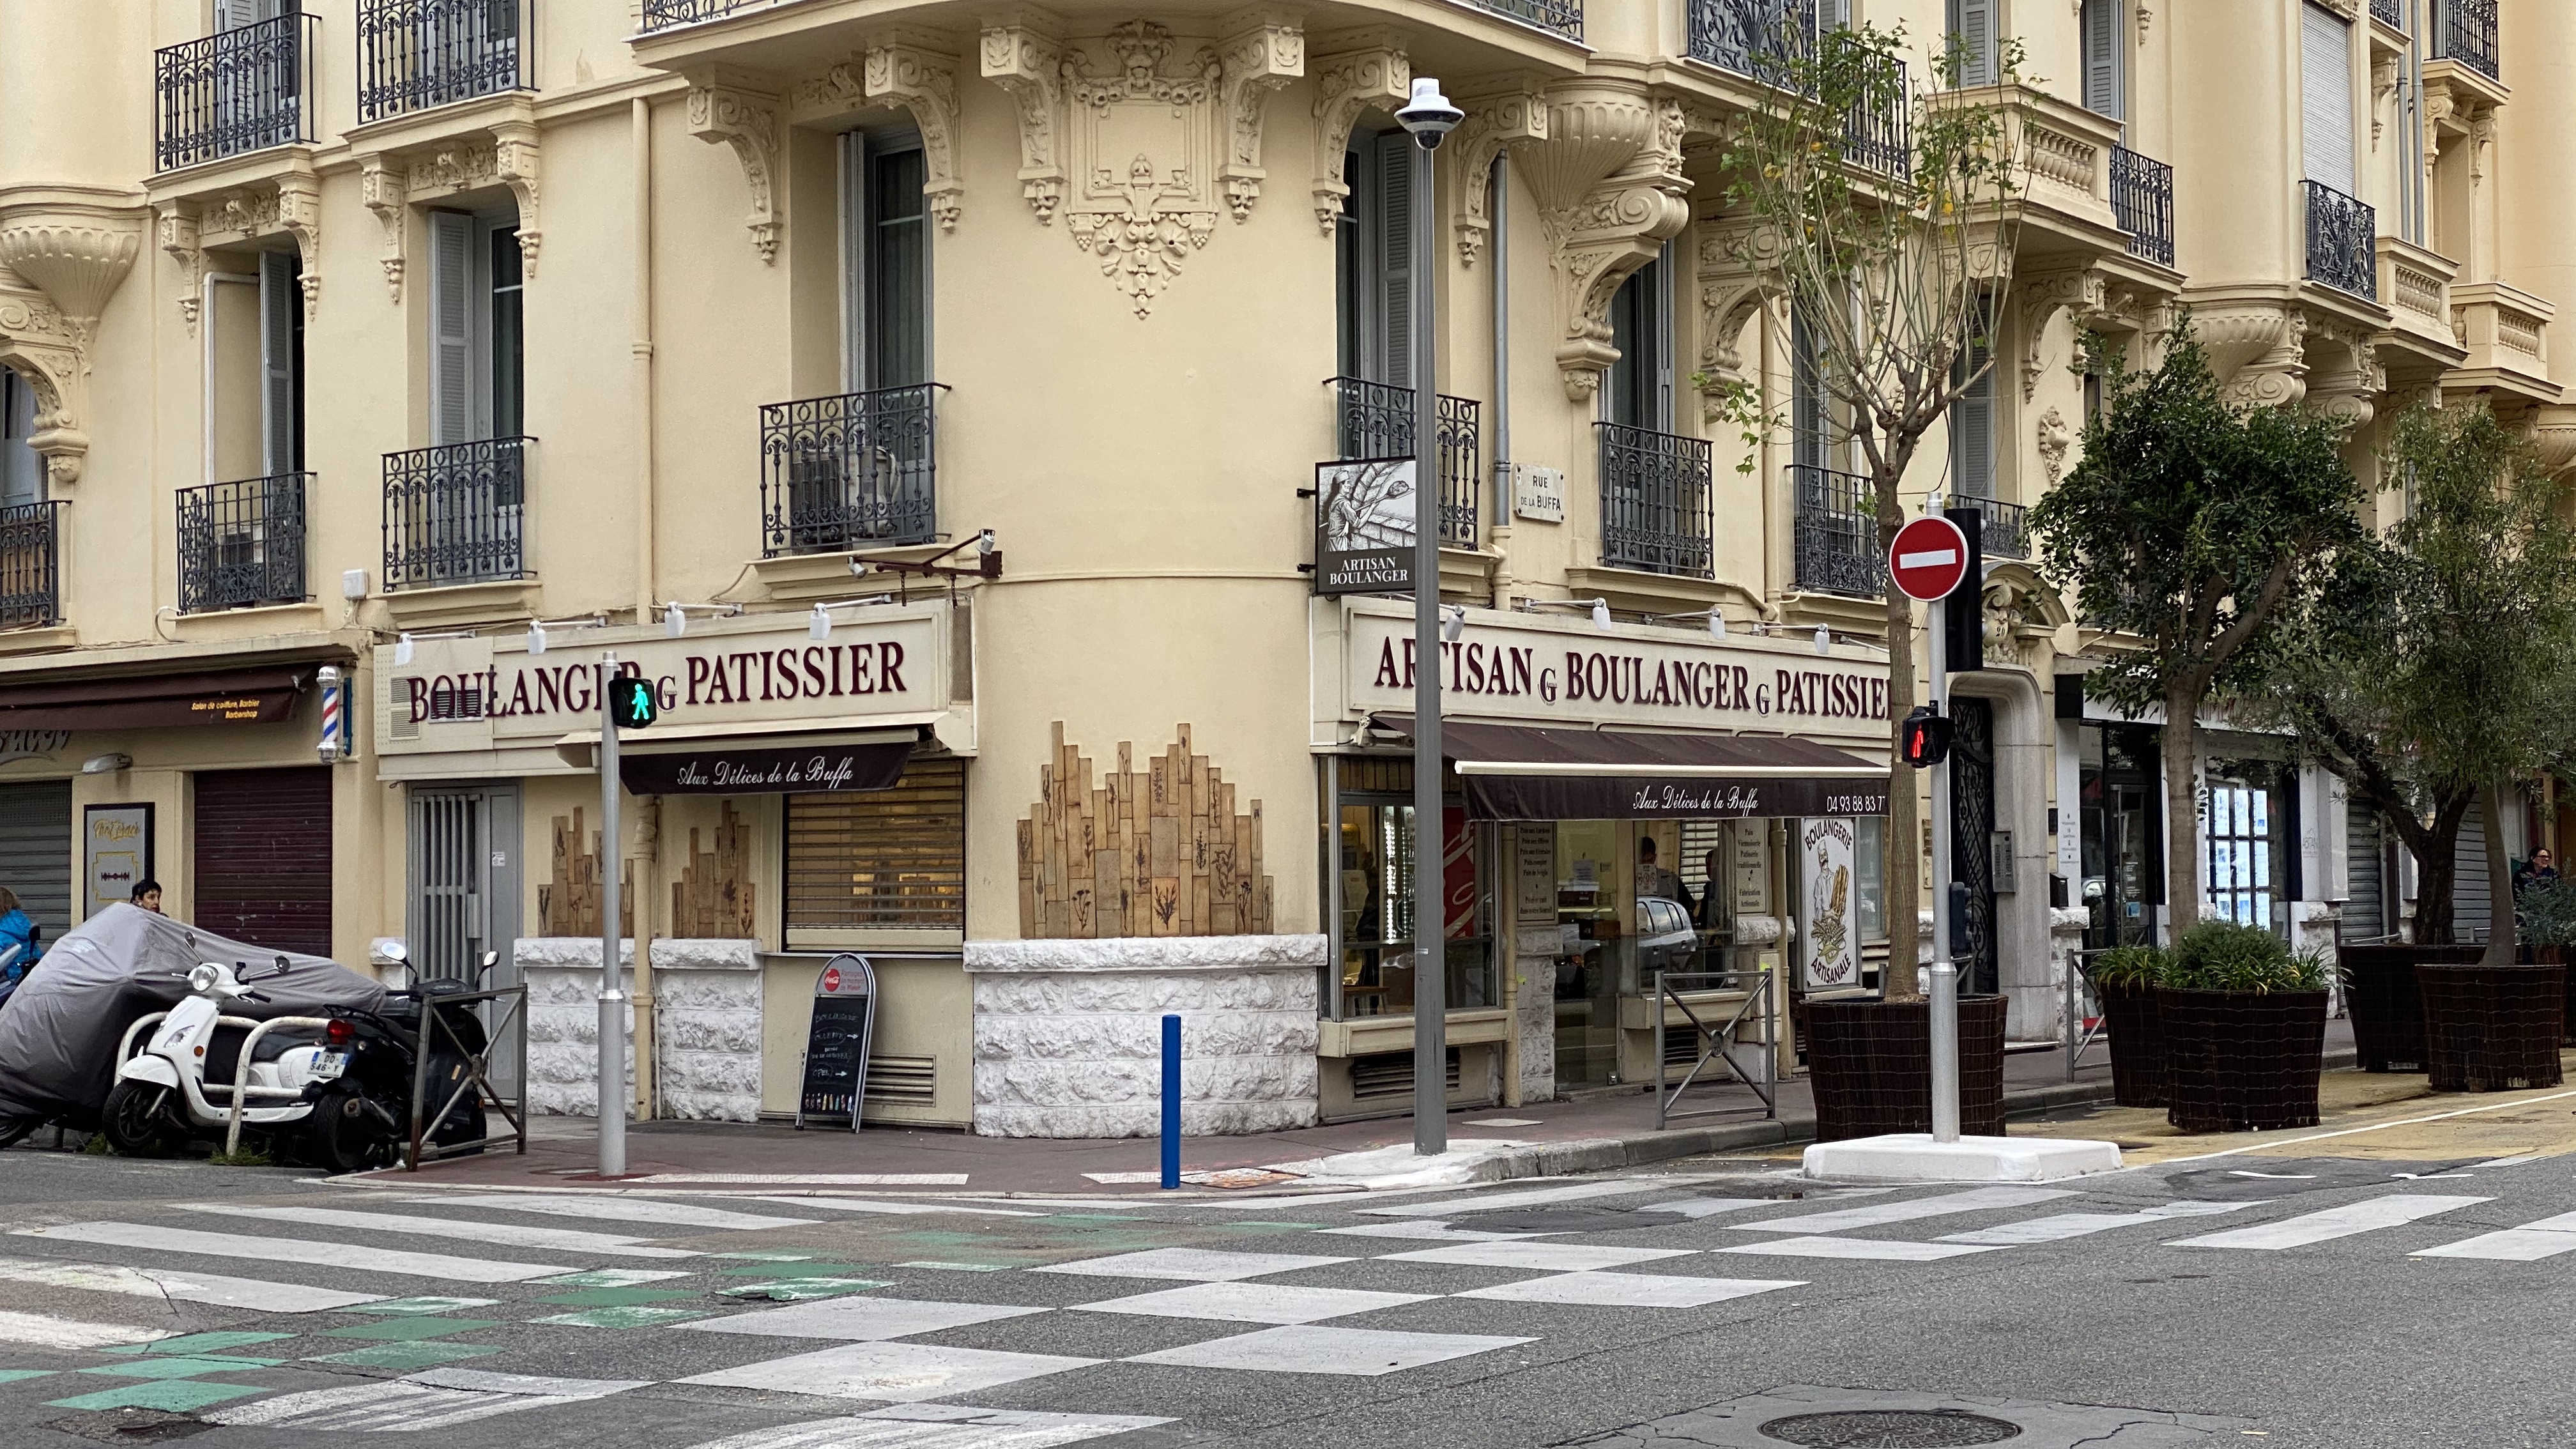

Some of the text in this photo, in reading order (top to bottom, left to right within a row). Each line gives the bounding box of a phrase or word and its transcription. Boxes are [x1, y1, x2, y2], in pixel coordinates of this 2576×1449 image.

[1533, 475, 1547, 488] RUE
[1521, 494, 1561, 511] DE LA BUFFA
[1341, 556, 1396, 572] ARTISAN
[1329, 569, 1409, 585] BOULANGER
[686, 641, 907, 705] PATISSIER
[1566, 652, 1751, 711] BOULANGER
[1777, 669, 1892, 721] PATISSIE
[192, 702, 207, 710] Salon
[208, 702, 215, 710] de
[239, 700, 260, 708] Barbier
[226, 710, 258, 719] Barbershop
[677, 755, 854, 790] Aux Délices de la Buffa
[1632, 785, 1658, 809] Aux
[1661, 785, 1699, 809] Délices
[1701, 789, 1712, 809] de
[1713, 789, 1724, 809] la
[1727, 785, 1759, 817] Buffa
[1827, 795, 1838, 812] 04
[1840, 795, 1850, 812] 93
[1853, 795, 1863, 811] 88
[1866, 795, 1876, 811] 83
[1804, 819, 1852, 852] BOULANGERIE
[1811, 953, 1851, 984] ARTISANALE
